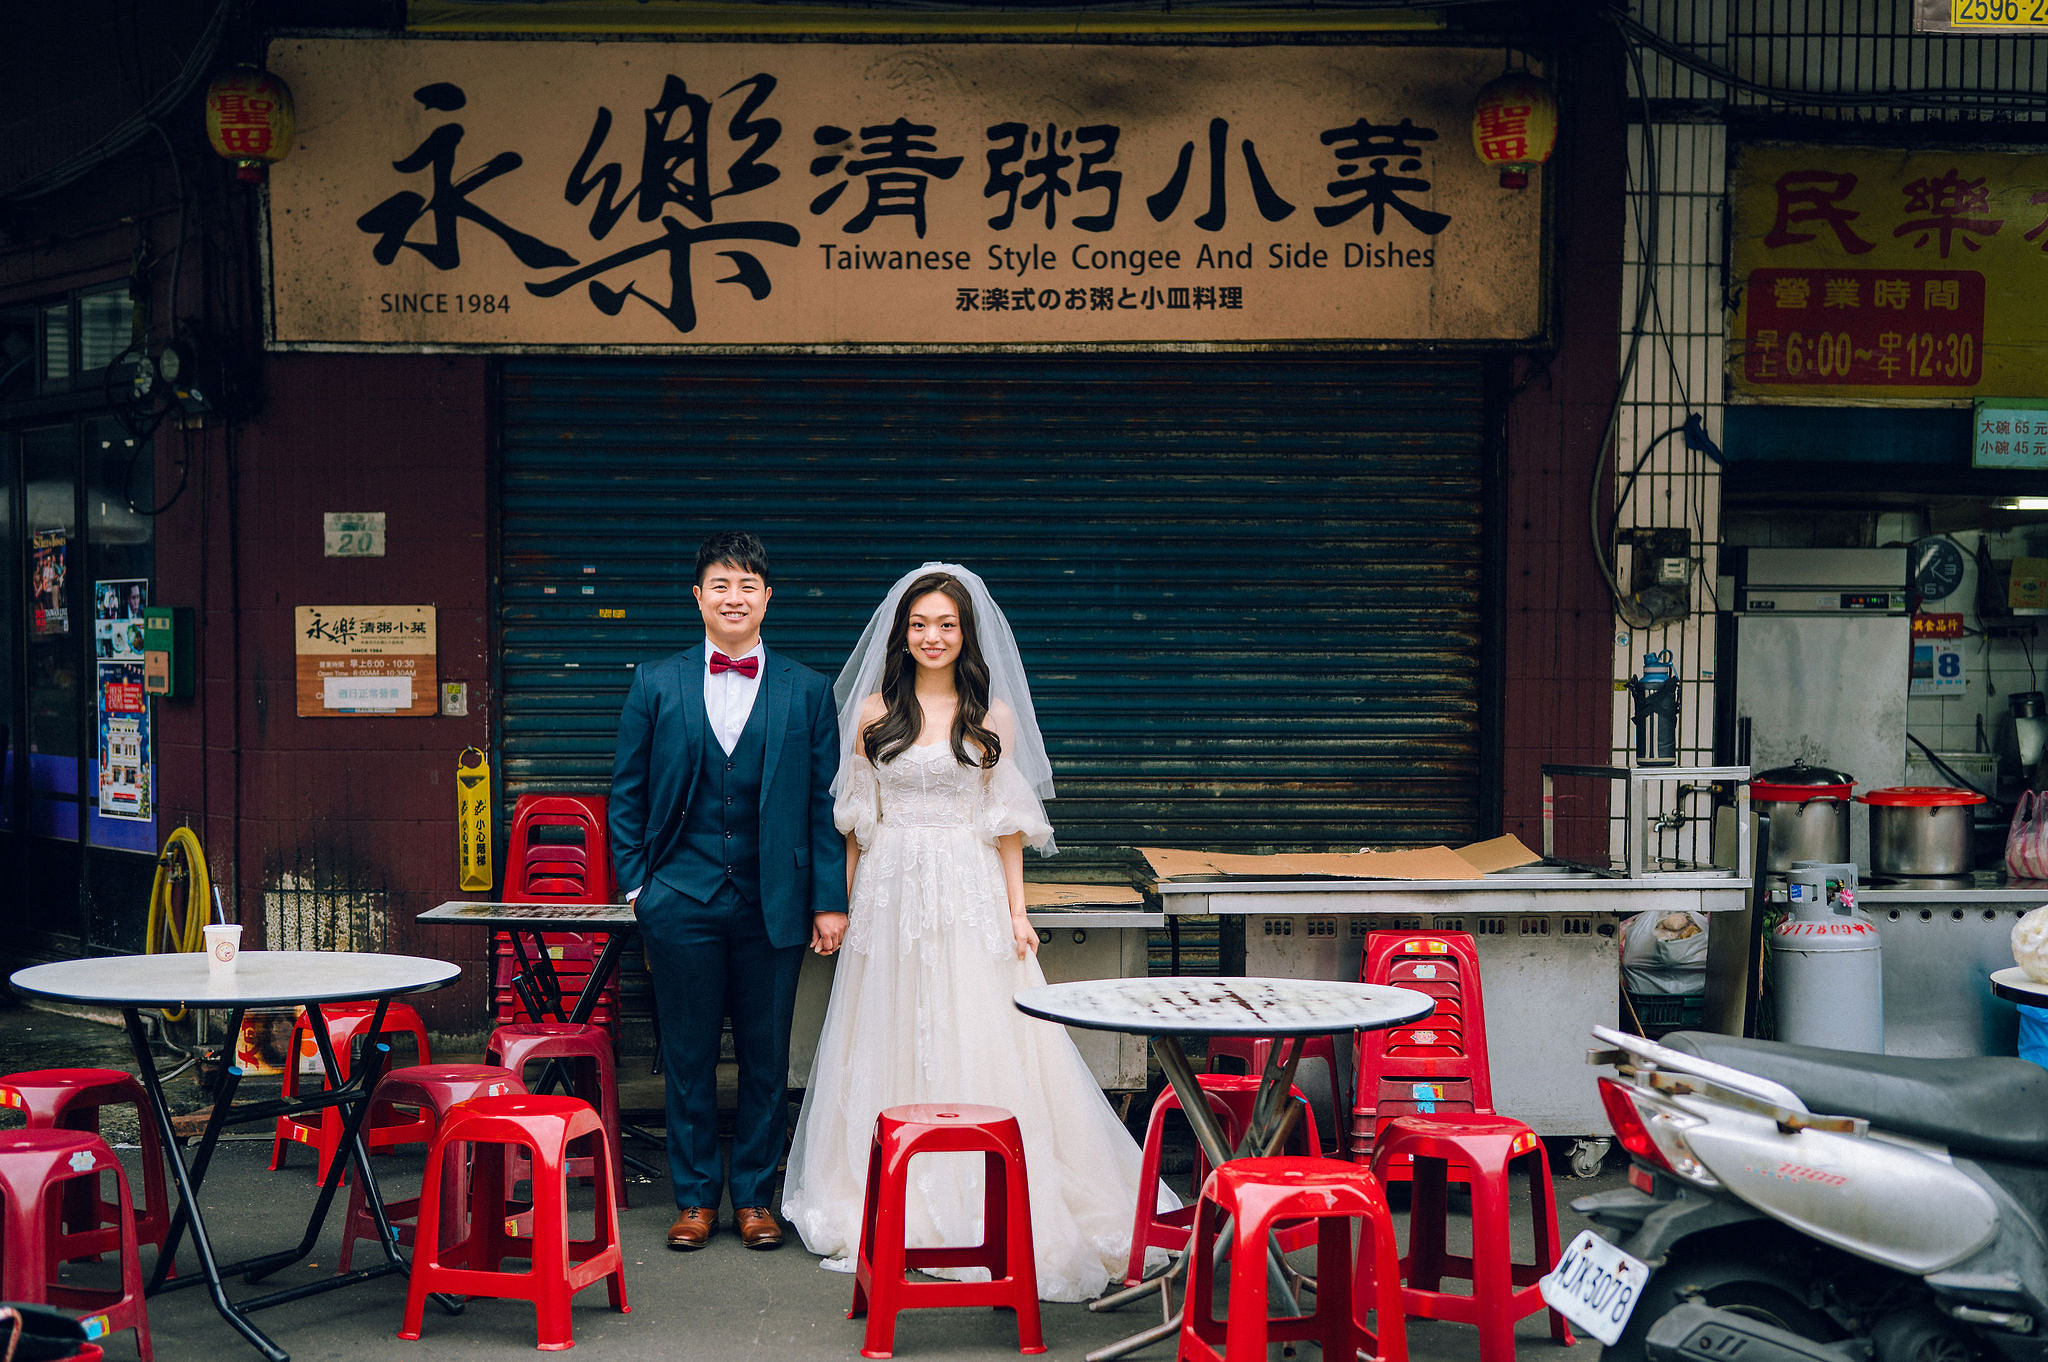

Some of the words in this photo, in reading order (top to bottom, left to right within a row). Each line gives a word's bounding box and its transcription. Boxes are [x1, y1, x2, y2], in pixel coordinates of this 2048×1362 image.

[1960, 0, 2048, 21] 2596-2
[1764, 168, 2048, 259] 民樂
[819, 244, 971, 270] Taiwanese
[988, 243, 1057, 276] Style
[1072, 243, 1181, 276] Congee
[1196, 242, 1252, 269] And
[1268, 242, 1328, 269] Side
[1344, 242, 1437, 271] Dishes
[380, 292, 448, 315] SINCE
[455, 293, 511, 314] 1984
[1773, 277, 1961, 311] 營業時間
[2015, 420, 2030, 434] 65
[2014, 441, 2029, 455] 45
[1938, 652, 1961, 678] 8
